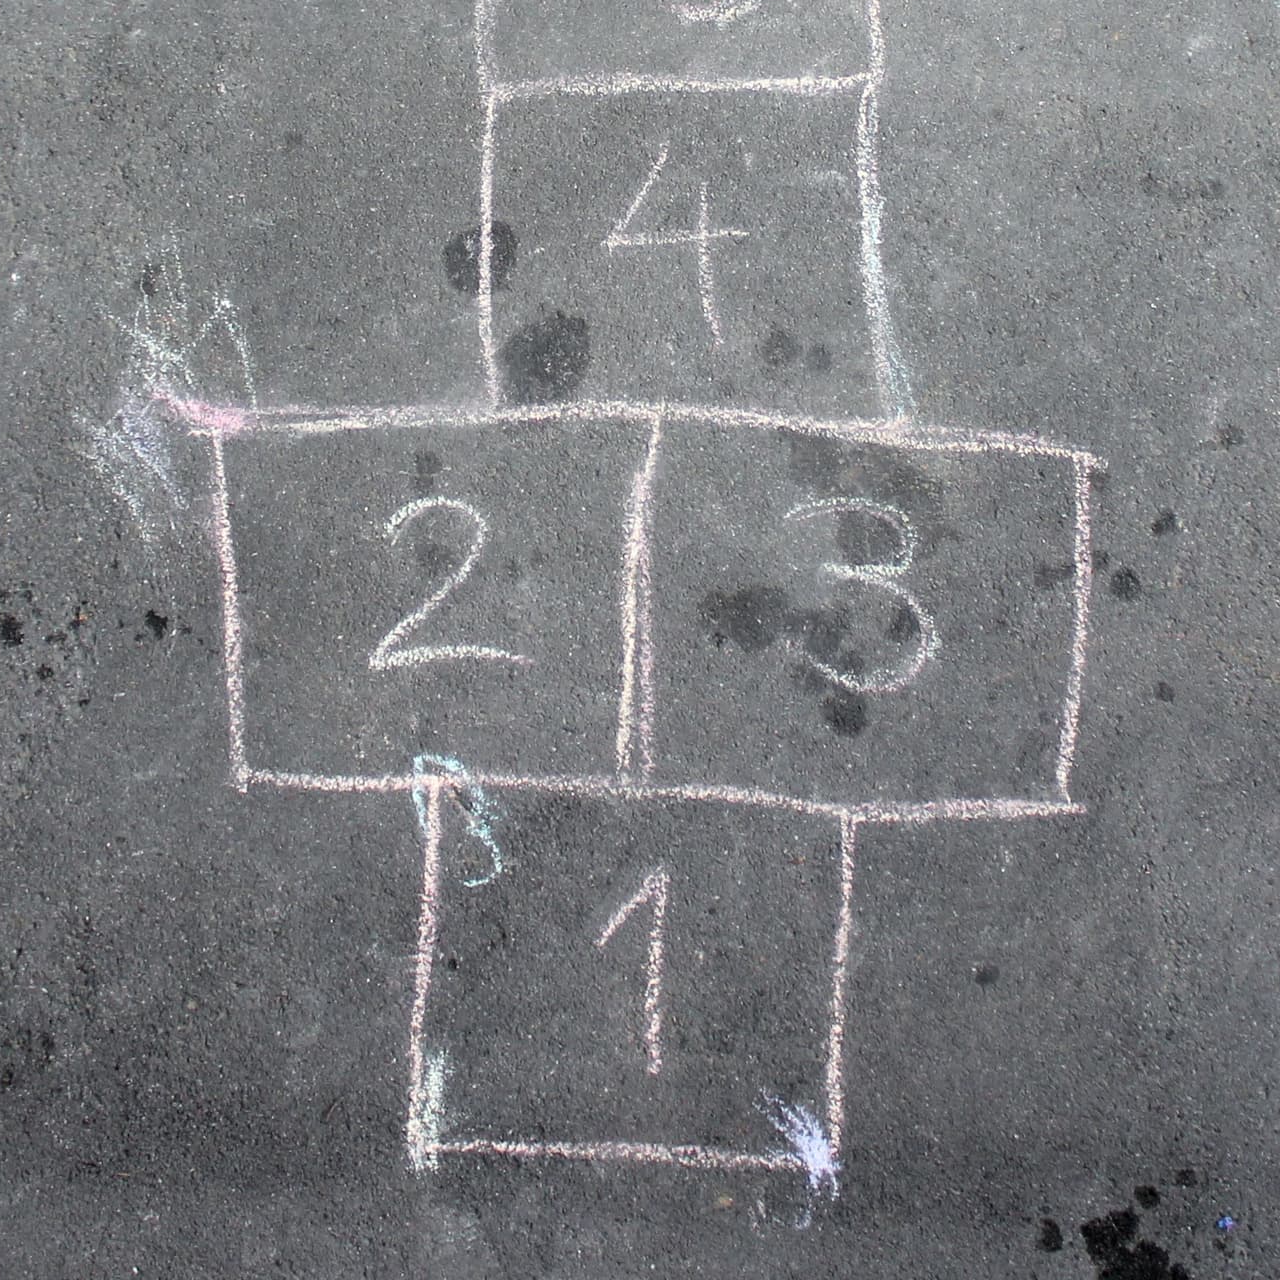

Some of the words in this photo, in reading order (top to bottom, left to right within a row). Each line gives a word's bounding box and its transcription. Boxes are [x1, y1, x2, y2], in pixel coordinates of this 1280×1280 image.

[604, 141, 751, 349] 4
[368, 494, 535, 670] 2
[780, 494, 940, 694] 3
[594, 862, 669, 1075] 1
